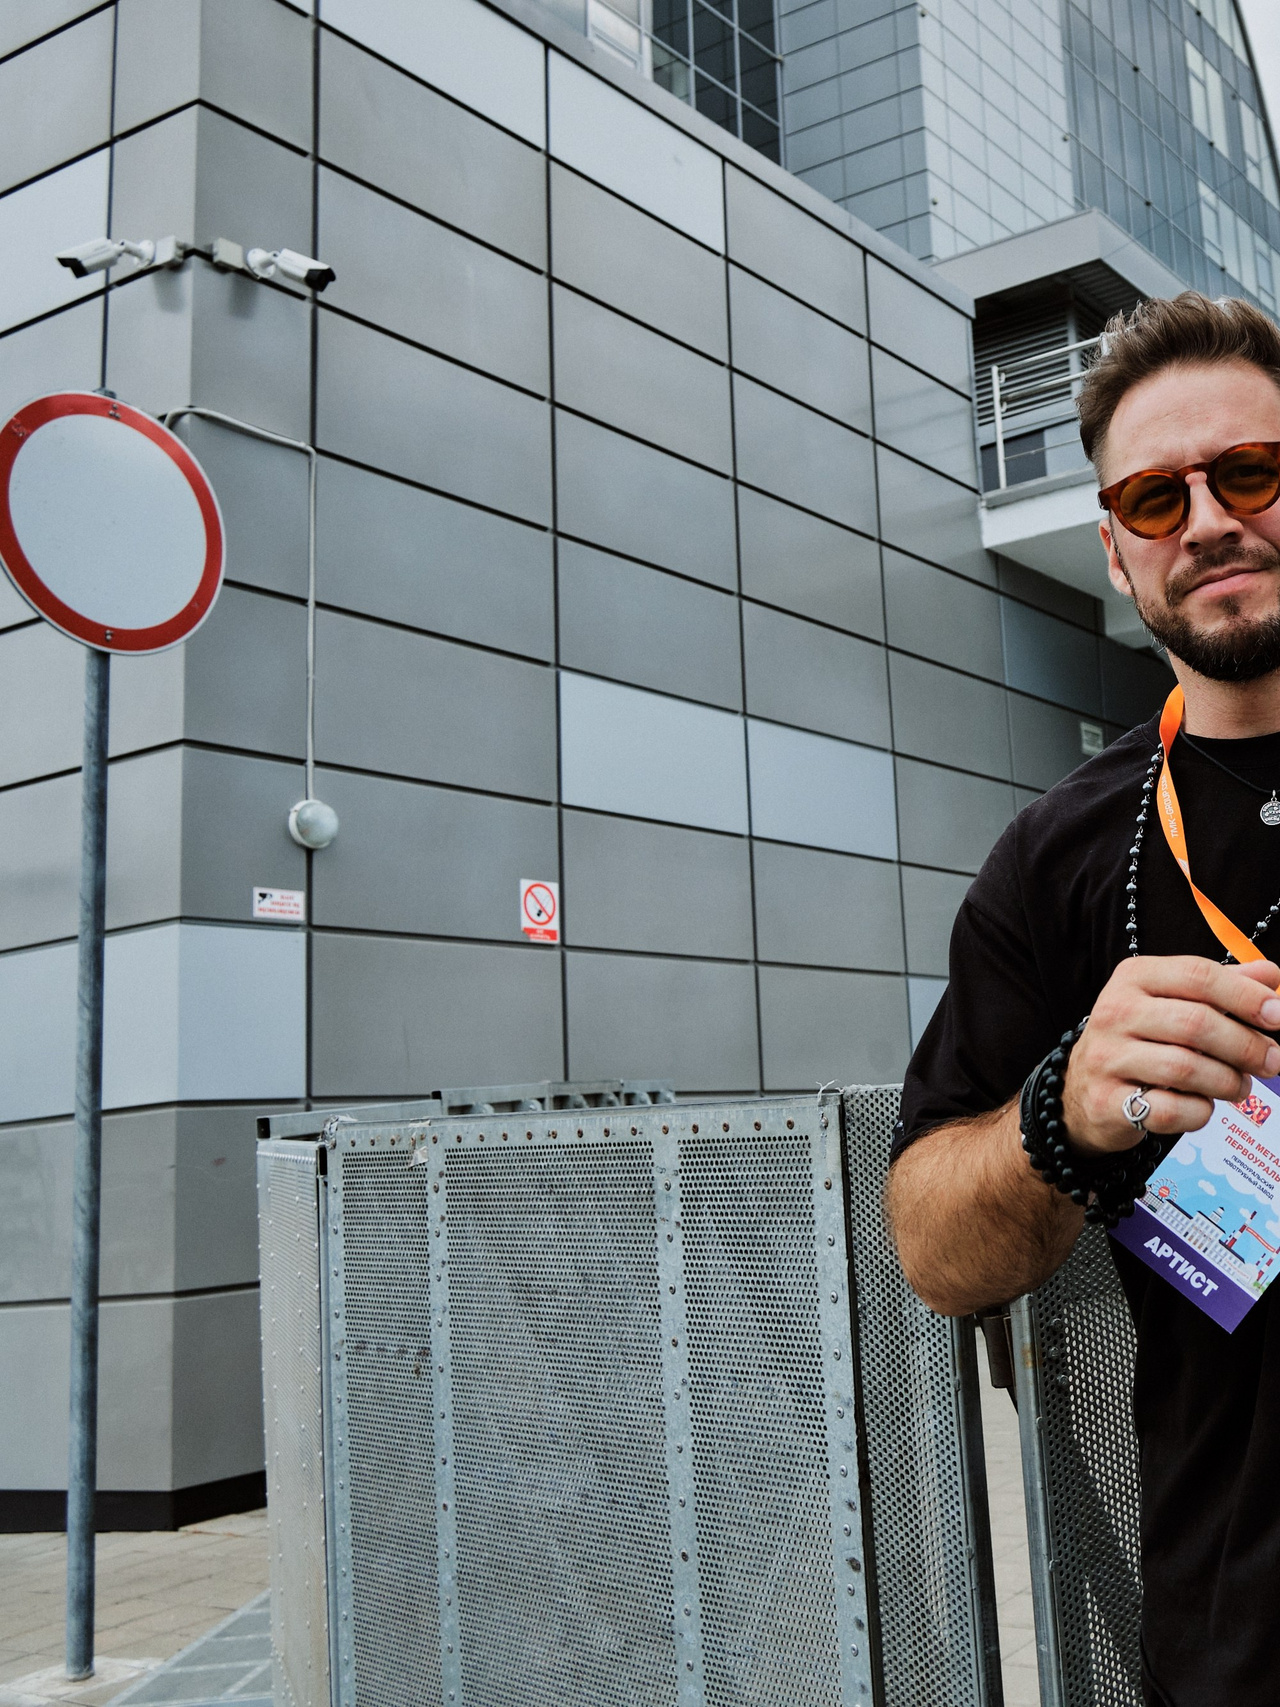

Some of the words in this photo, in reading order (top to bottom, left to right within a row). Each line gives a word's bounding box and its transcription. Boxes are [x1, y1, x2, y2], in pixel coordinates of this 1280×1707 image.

[1221, 1117, 1228, 1125] С
[1228, 1124, 1255, 1145] ДНЁМ
[1223, 1158, 1258, 1186] НОВОТРУБНЫЙ
[1256, 1184, 1274, 1200] ЗАВОД
[1231, 1155, 1275, 1190] ПЕРВОУРАЛЬСКИЙ
[1144, 1236, 1219, 1297] АРТИСТ
